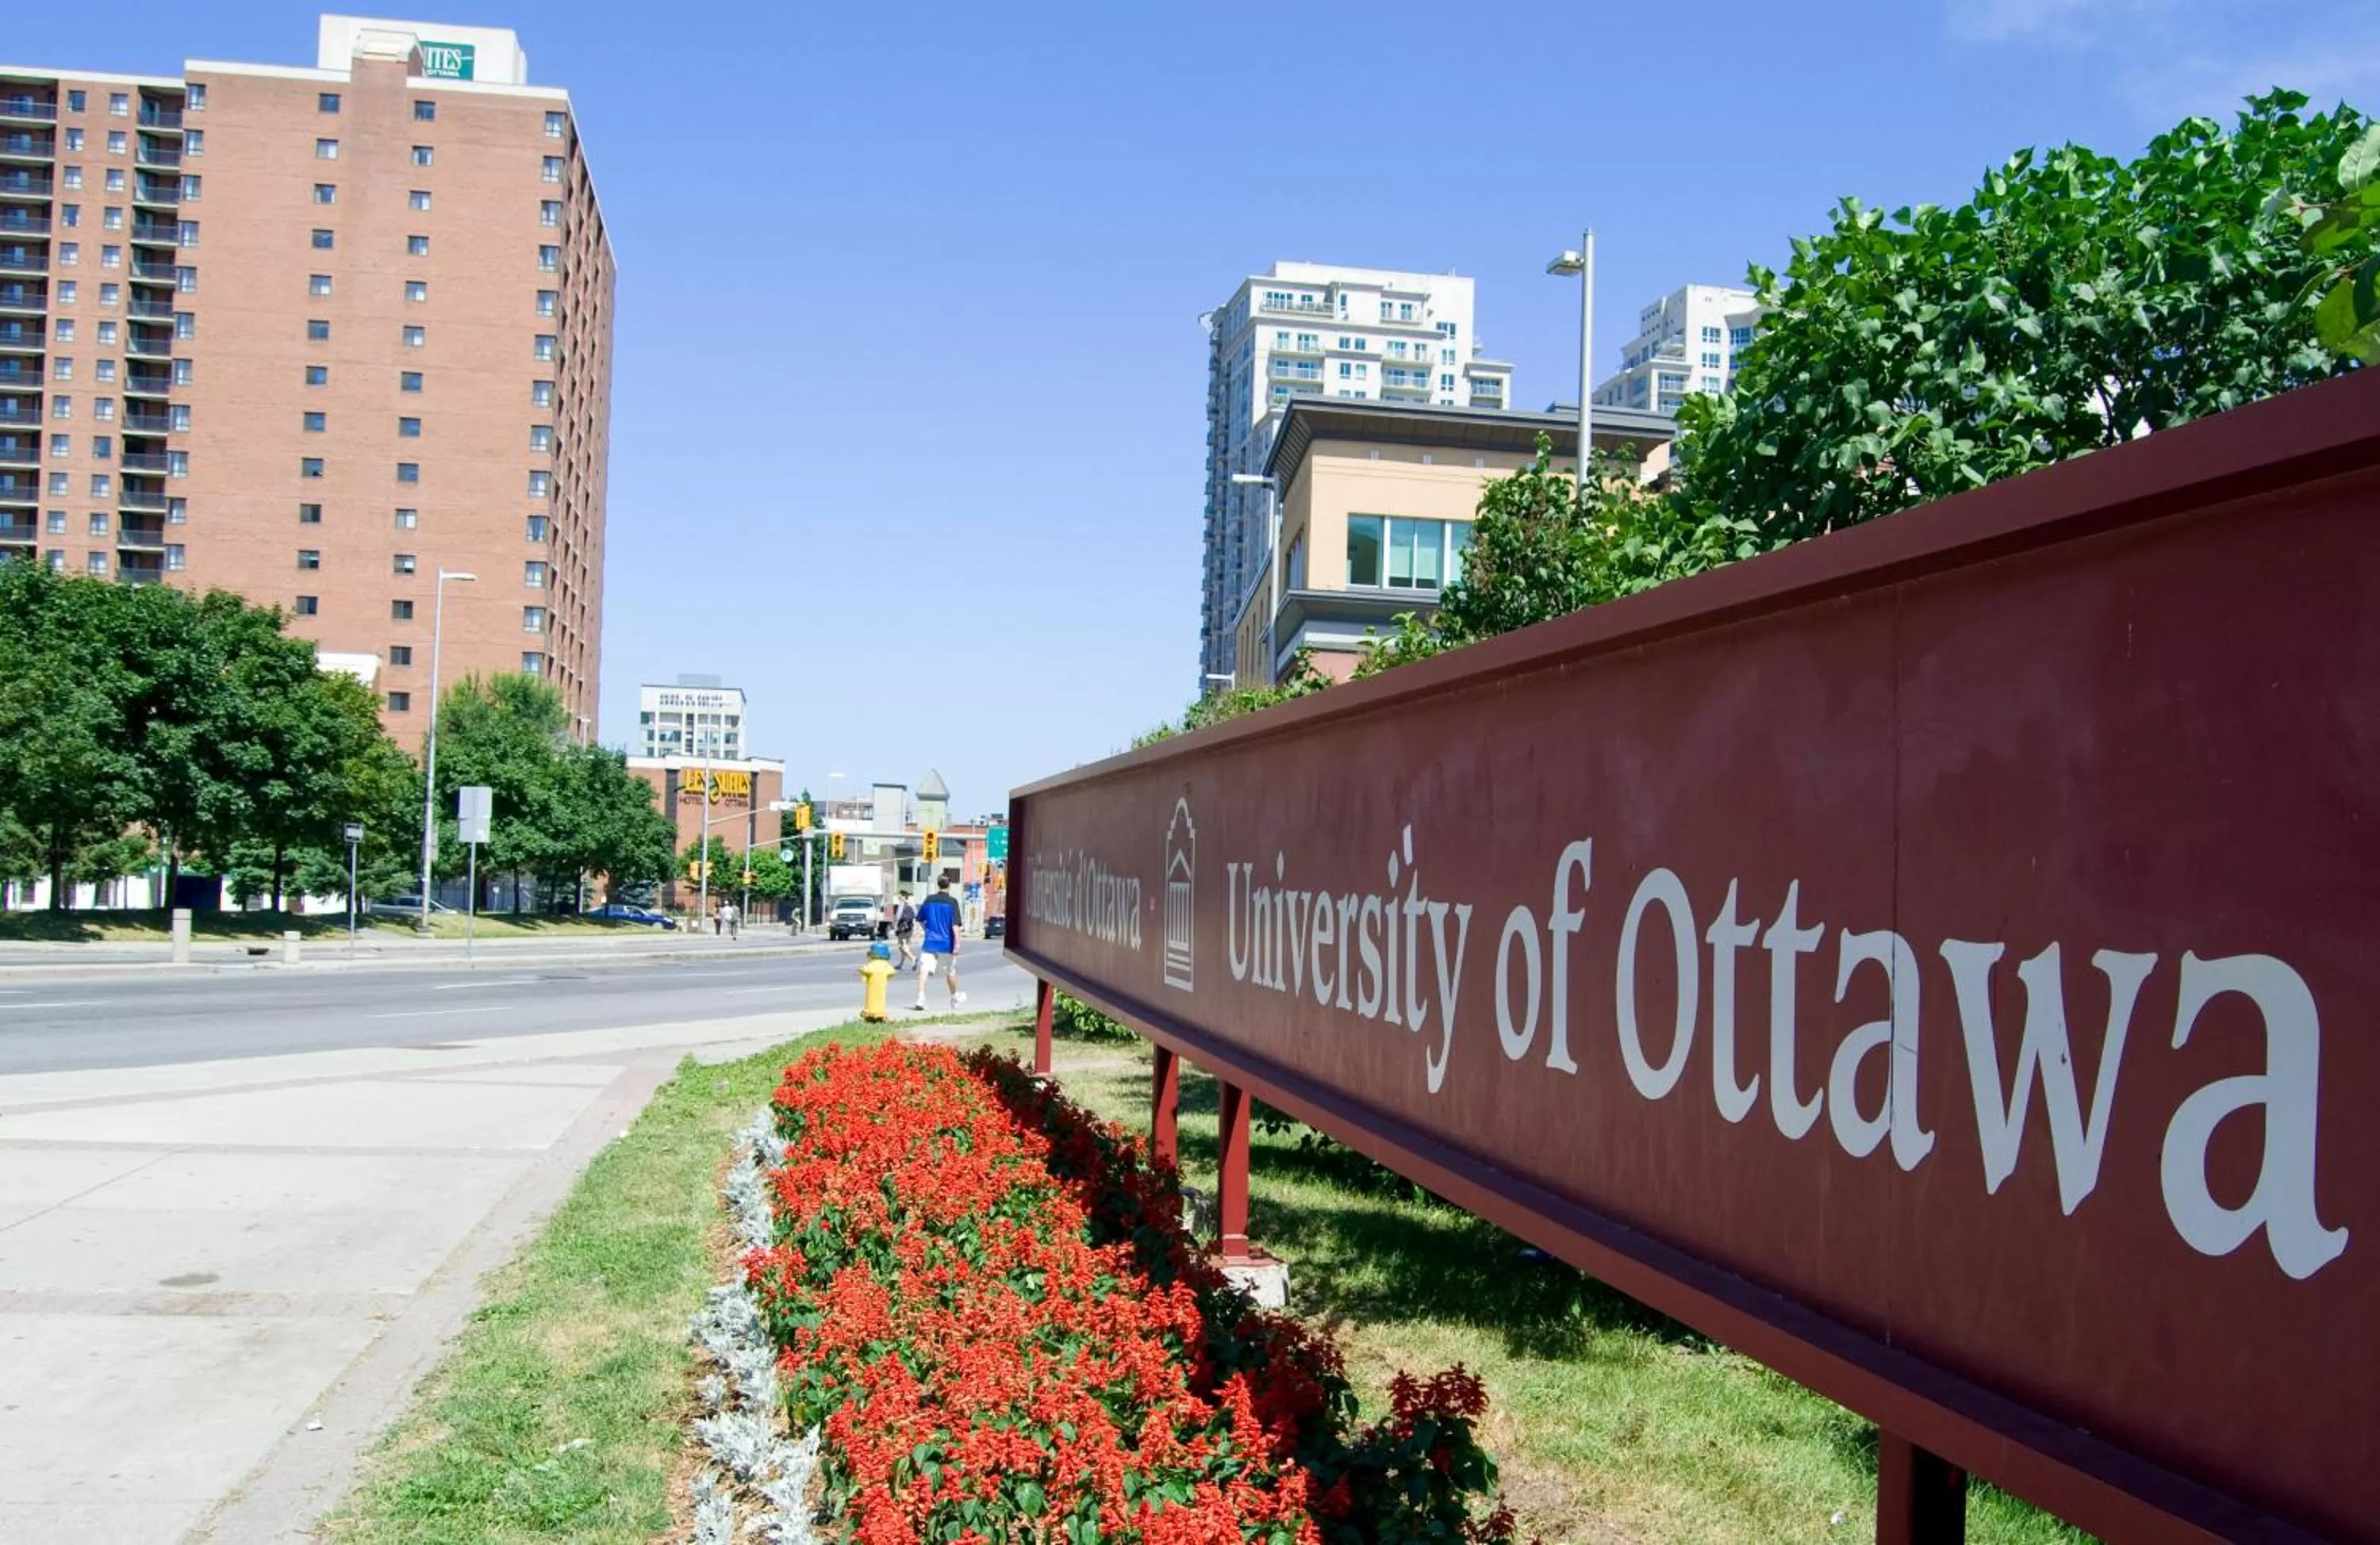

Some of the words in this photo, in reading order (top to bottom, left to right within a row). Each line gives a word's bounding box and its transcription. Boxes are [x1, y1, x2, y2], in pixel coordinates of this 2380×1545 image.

[423, 47, 462, 70] ITES
[1074, 849, 1142, 952] d'Ottawa
[1226, 824, 1472, 1095] University
[1495, 838, 1593, 1075] of
[1616, 867, 2349, 1279] Ottawa
